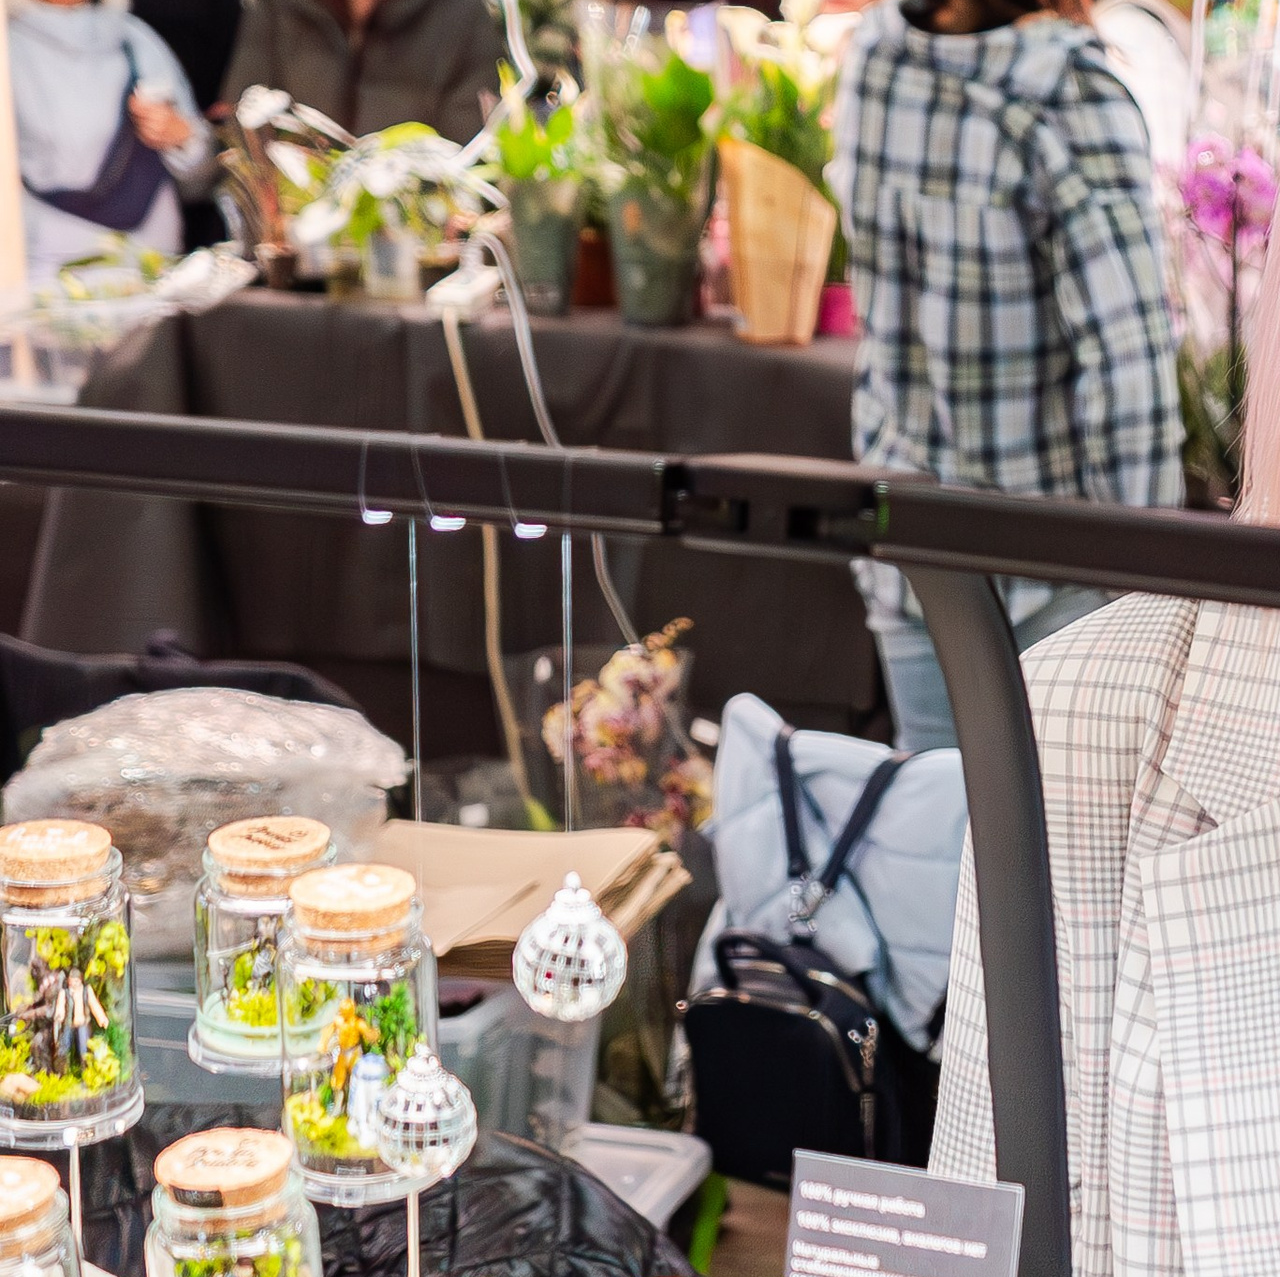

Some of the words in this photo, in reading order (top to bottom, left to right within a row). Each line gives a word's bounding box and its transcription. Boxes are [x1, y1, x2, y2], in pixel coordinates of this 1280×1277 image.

[799, 1181, 832, 1201] 100%
[834, 1190, 878, 1209] ручная
[879, 1196, 925, 1218] работа
[797, 1211, 829, 1231] 100%
[831, 1218, 901, 1245] эксклюзив,
[903, 1231, 961, 1253] аналогов
[964, 1241, 987, 1257] нет
[793, 1240, 879, 1269] Натуральные
